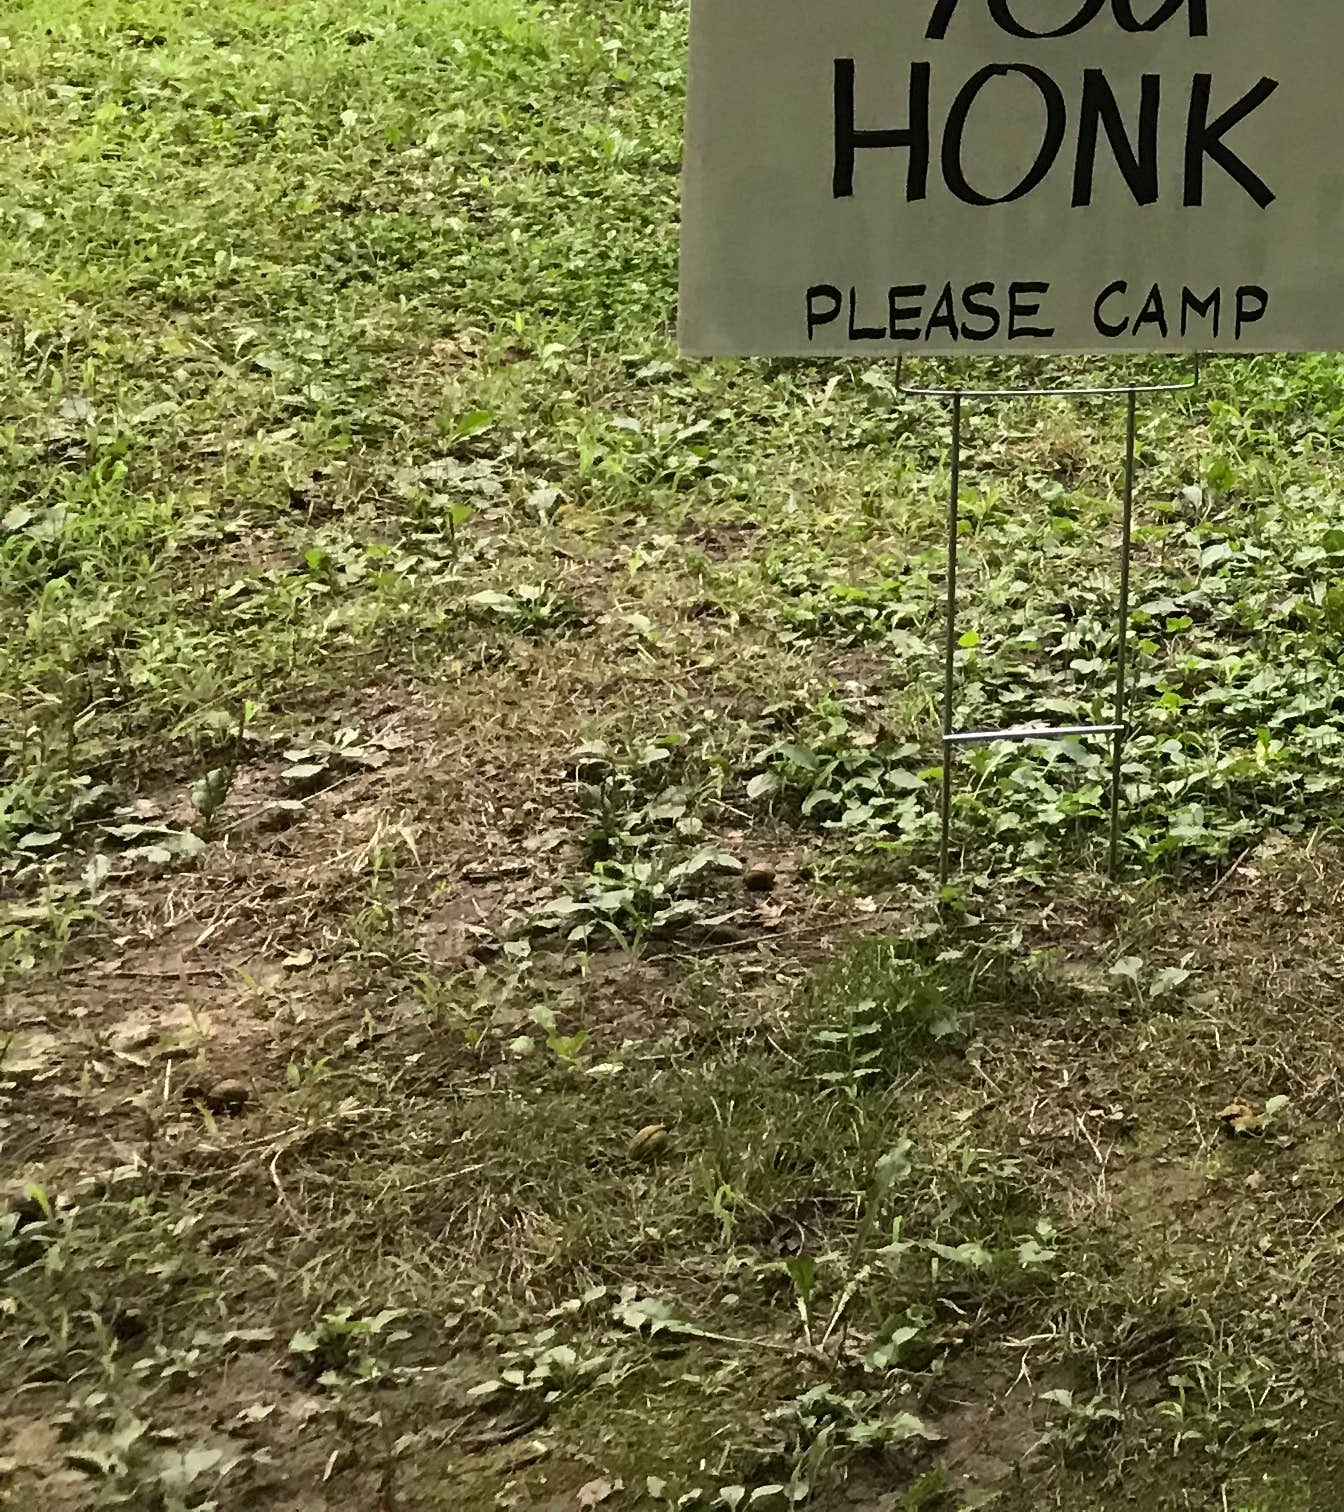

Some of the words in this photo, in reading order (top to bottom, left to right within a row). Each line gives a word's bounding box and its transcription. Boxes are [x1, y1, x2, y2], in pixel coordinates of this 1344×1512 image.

[832, 58, 1280, 210] HONK
[805, 280, 1055, 341] PLEASE
[1093, 280, 1269, 341] CAMP
